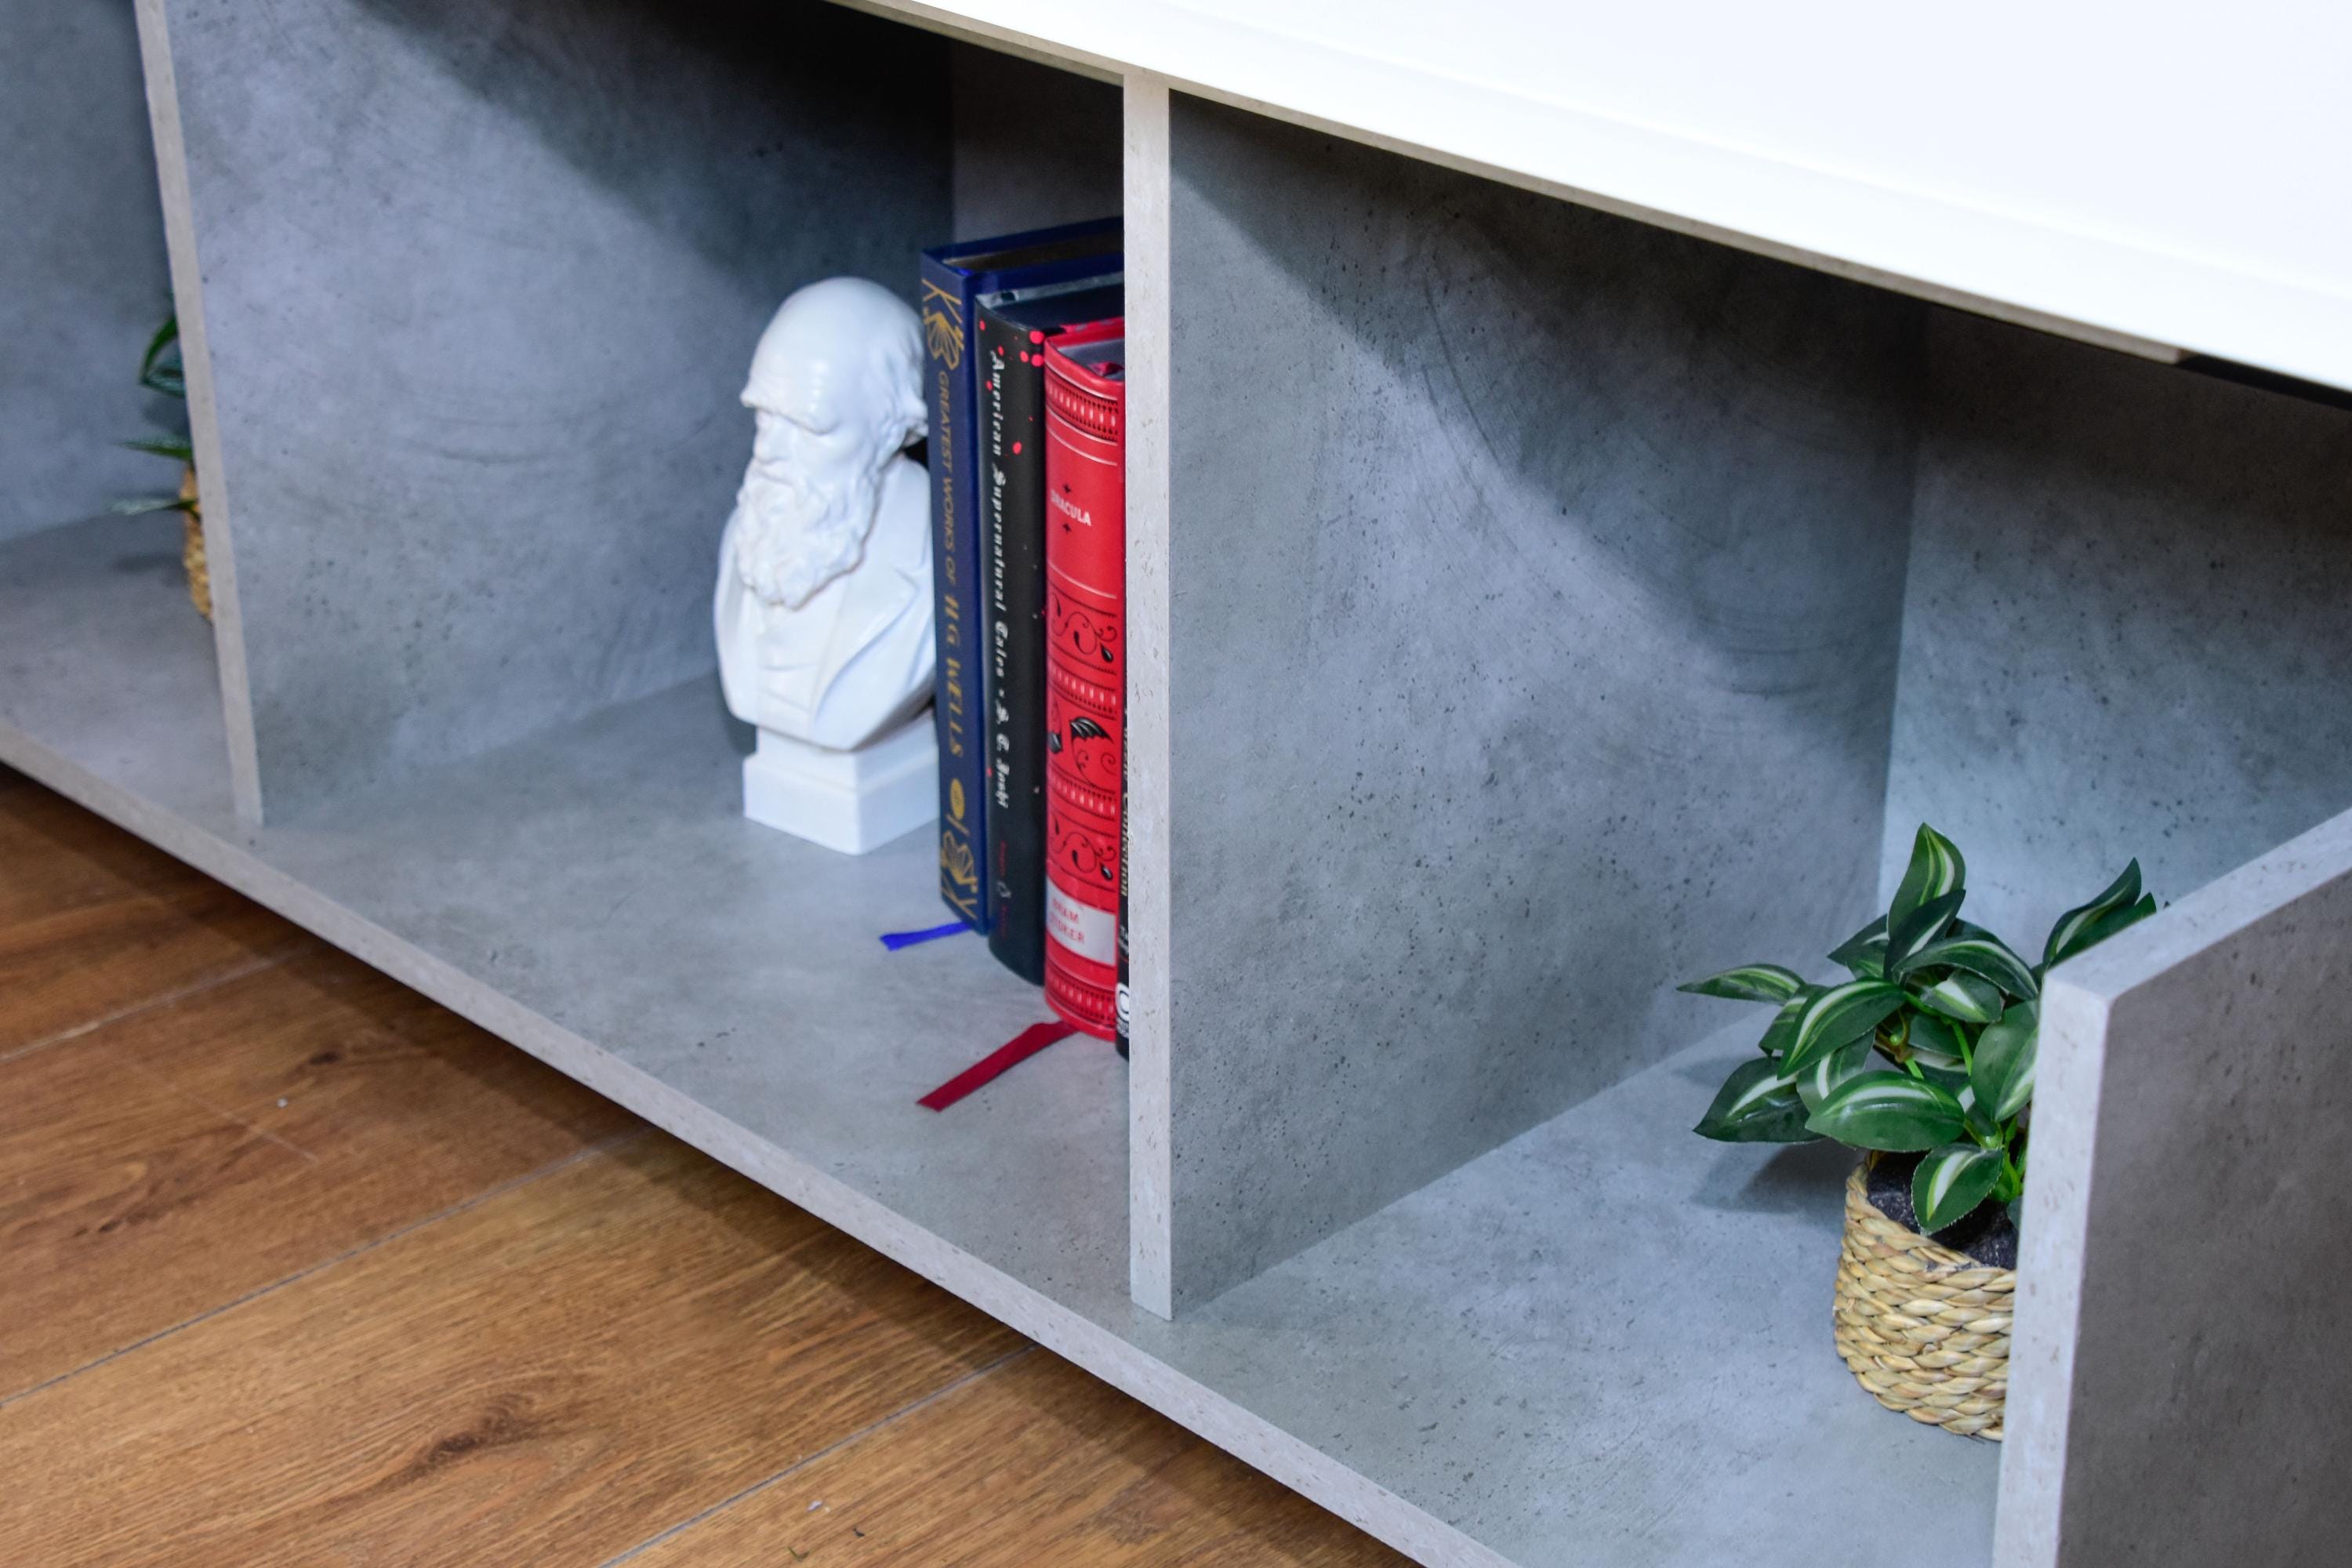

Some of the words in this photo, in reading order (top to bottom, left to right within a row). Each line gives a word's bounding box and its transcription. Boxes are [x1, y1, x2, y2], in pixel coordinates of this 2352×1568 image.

[938, 370, 953, 473] GREATEST
[990, 350, 1005, 456] American
[942, 477, 955, 553] WORKS
[990, 463, 1007, 612] Supernatural
[1051, 489, 1091, 526] DRACULA
[945, 556, 956, 584] OF
[994, 620, 1008, 677] Tales
[946, 657, 964, 758] WELLS
